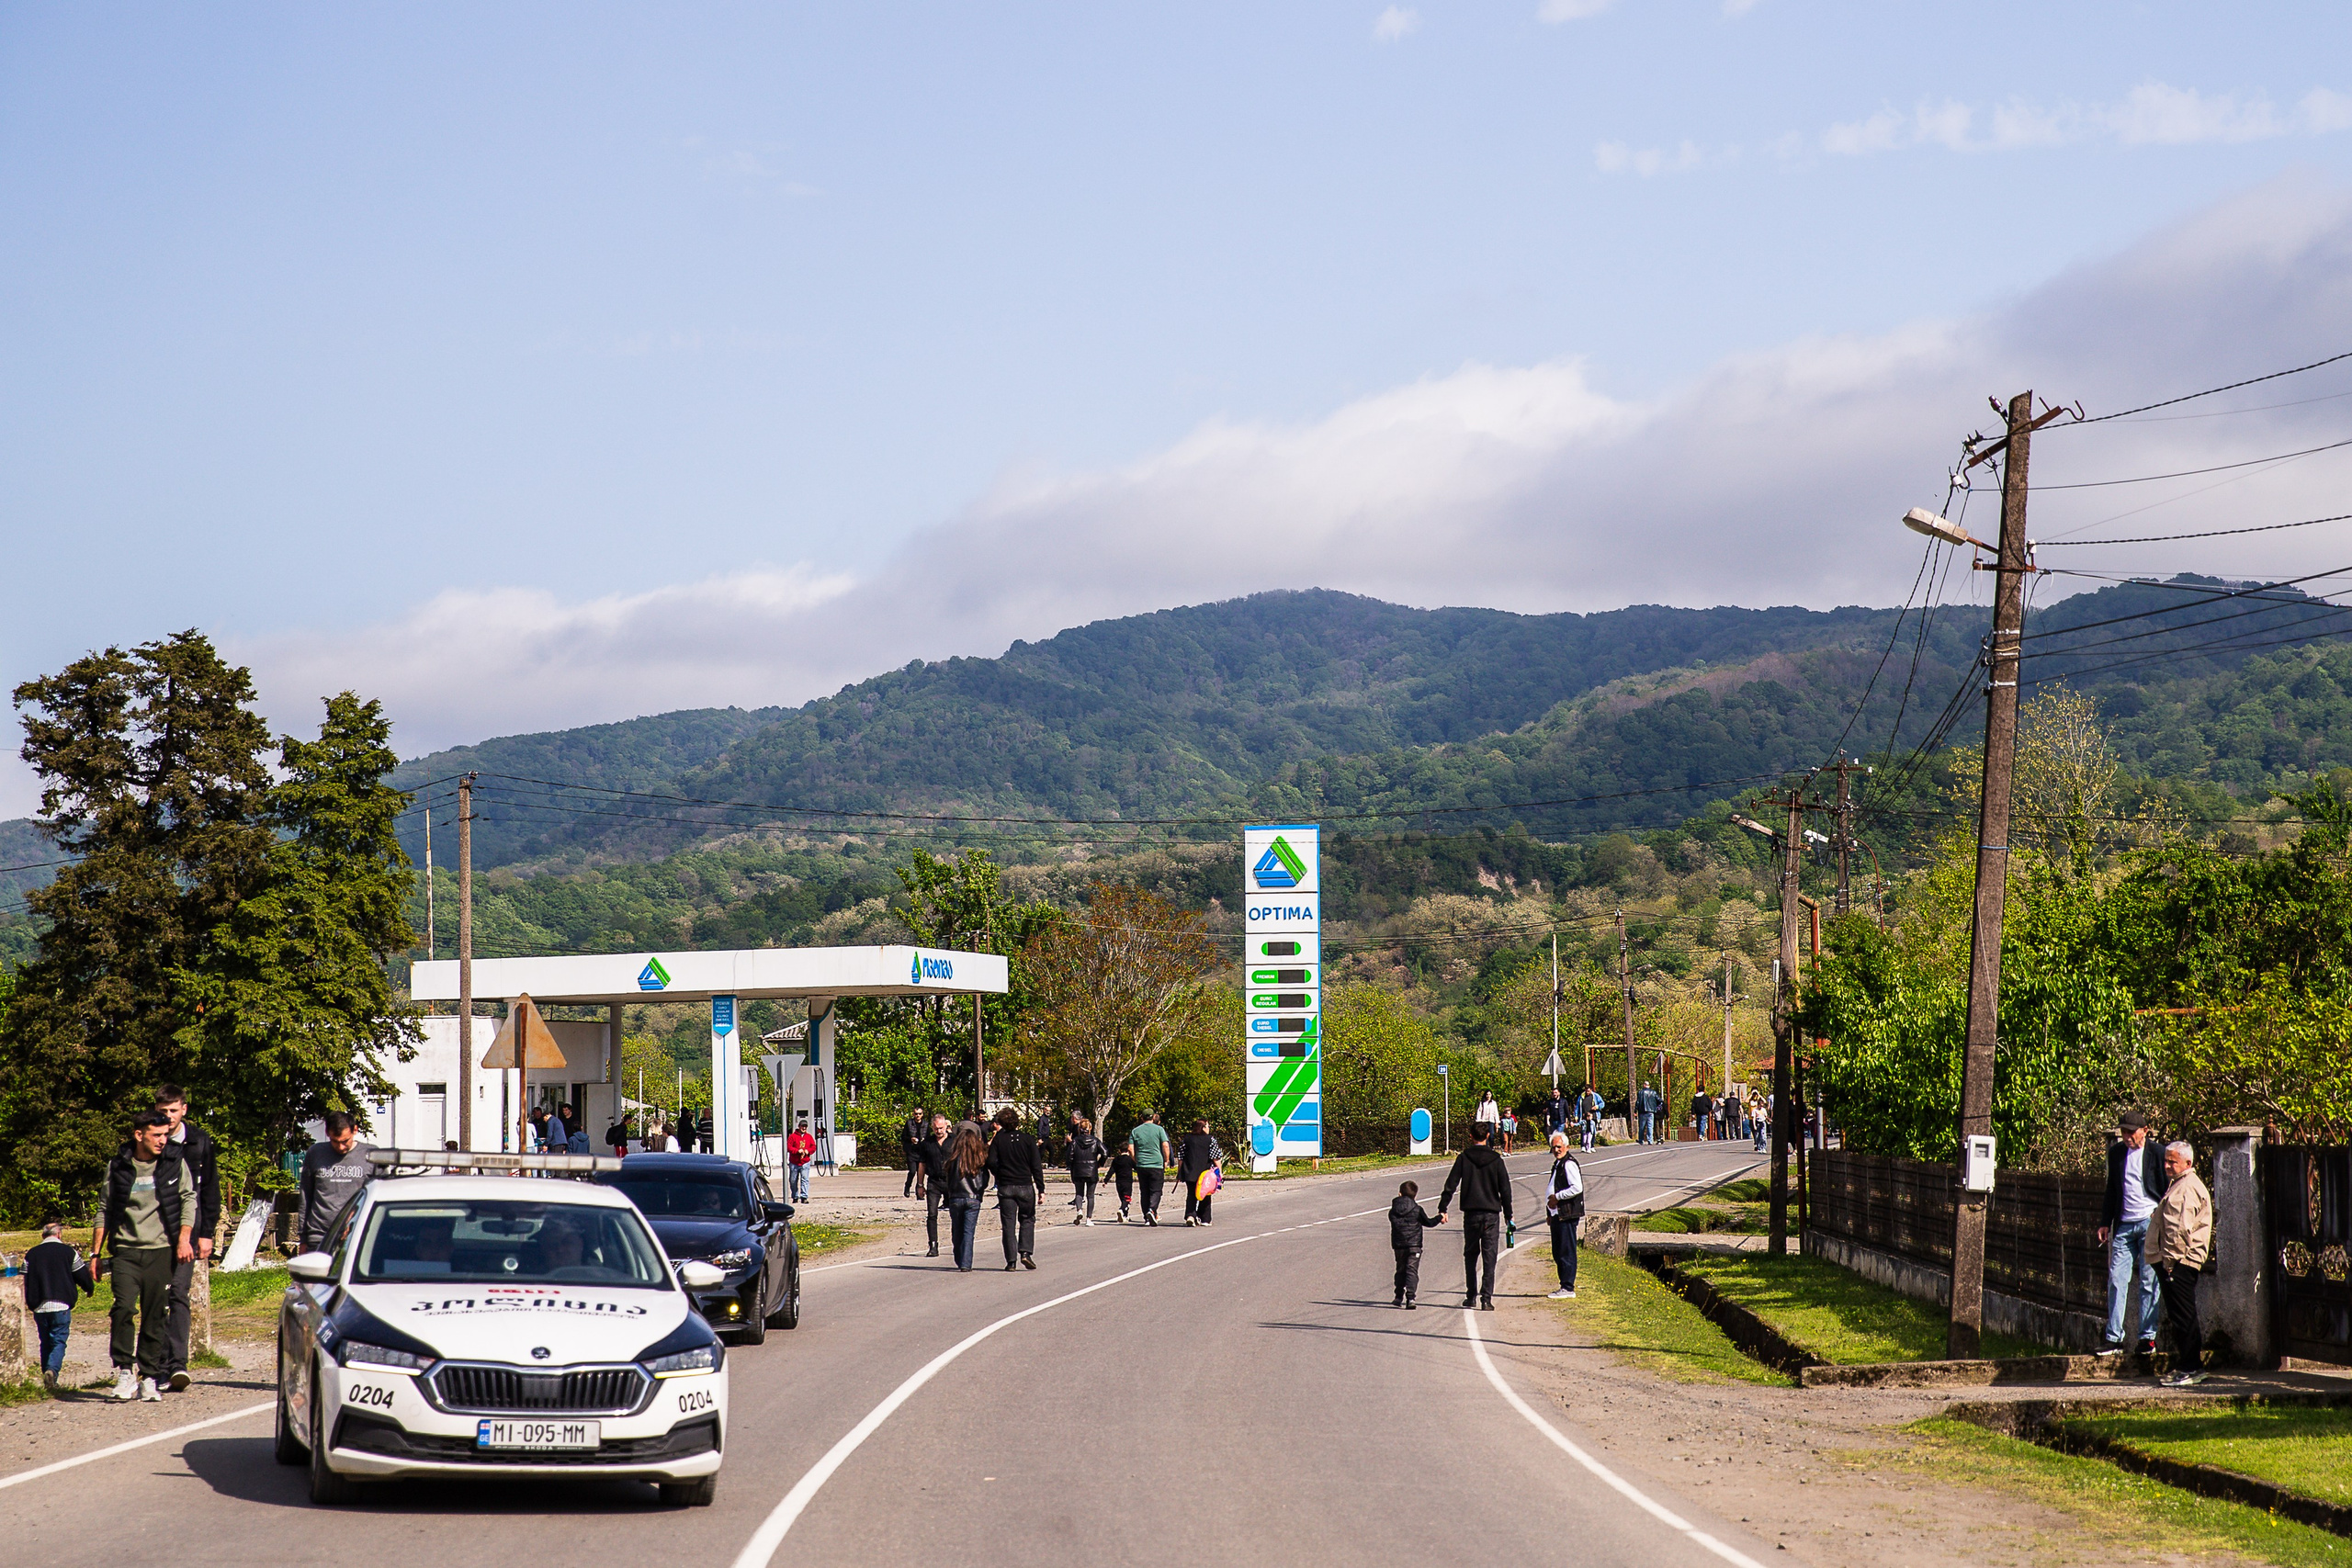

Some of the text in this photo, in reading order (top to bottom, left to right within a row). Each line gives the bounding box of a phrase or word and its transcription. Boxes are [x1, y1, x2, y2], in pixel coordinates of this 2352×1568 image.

[1249, 907, 1313, 920] OPTIMA
[411, 1297, 647, 1315] პოლიცია
[349, 1384, 394, 1408] 0204
[679, 1390, 713, 1413] 0204
[480, 1434, 490, 1442] GE
[493, 1424, 584, 1443] MI-095-MM
